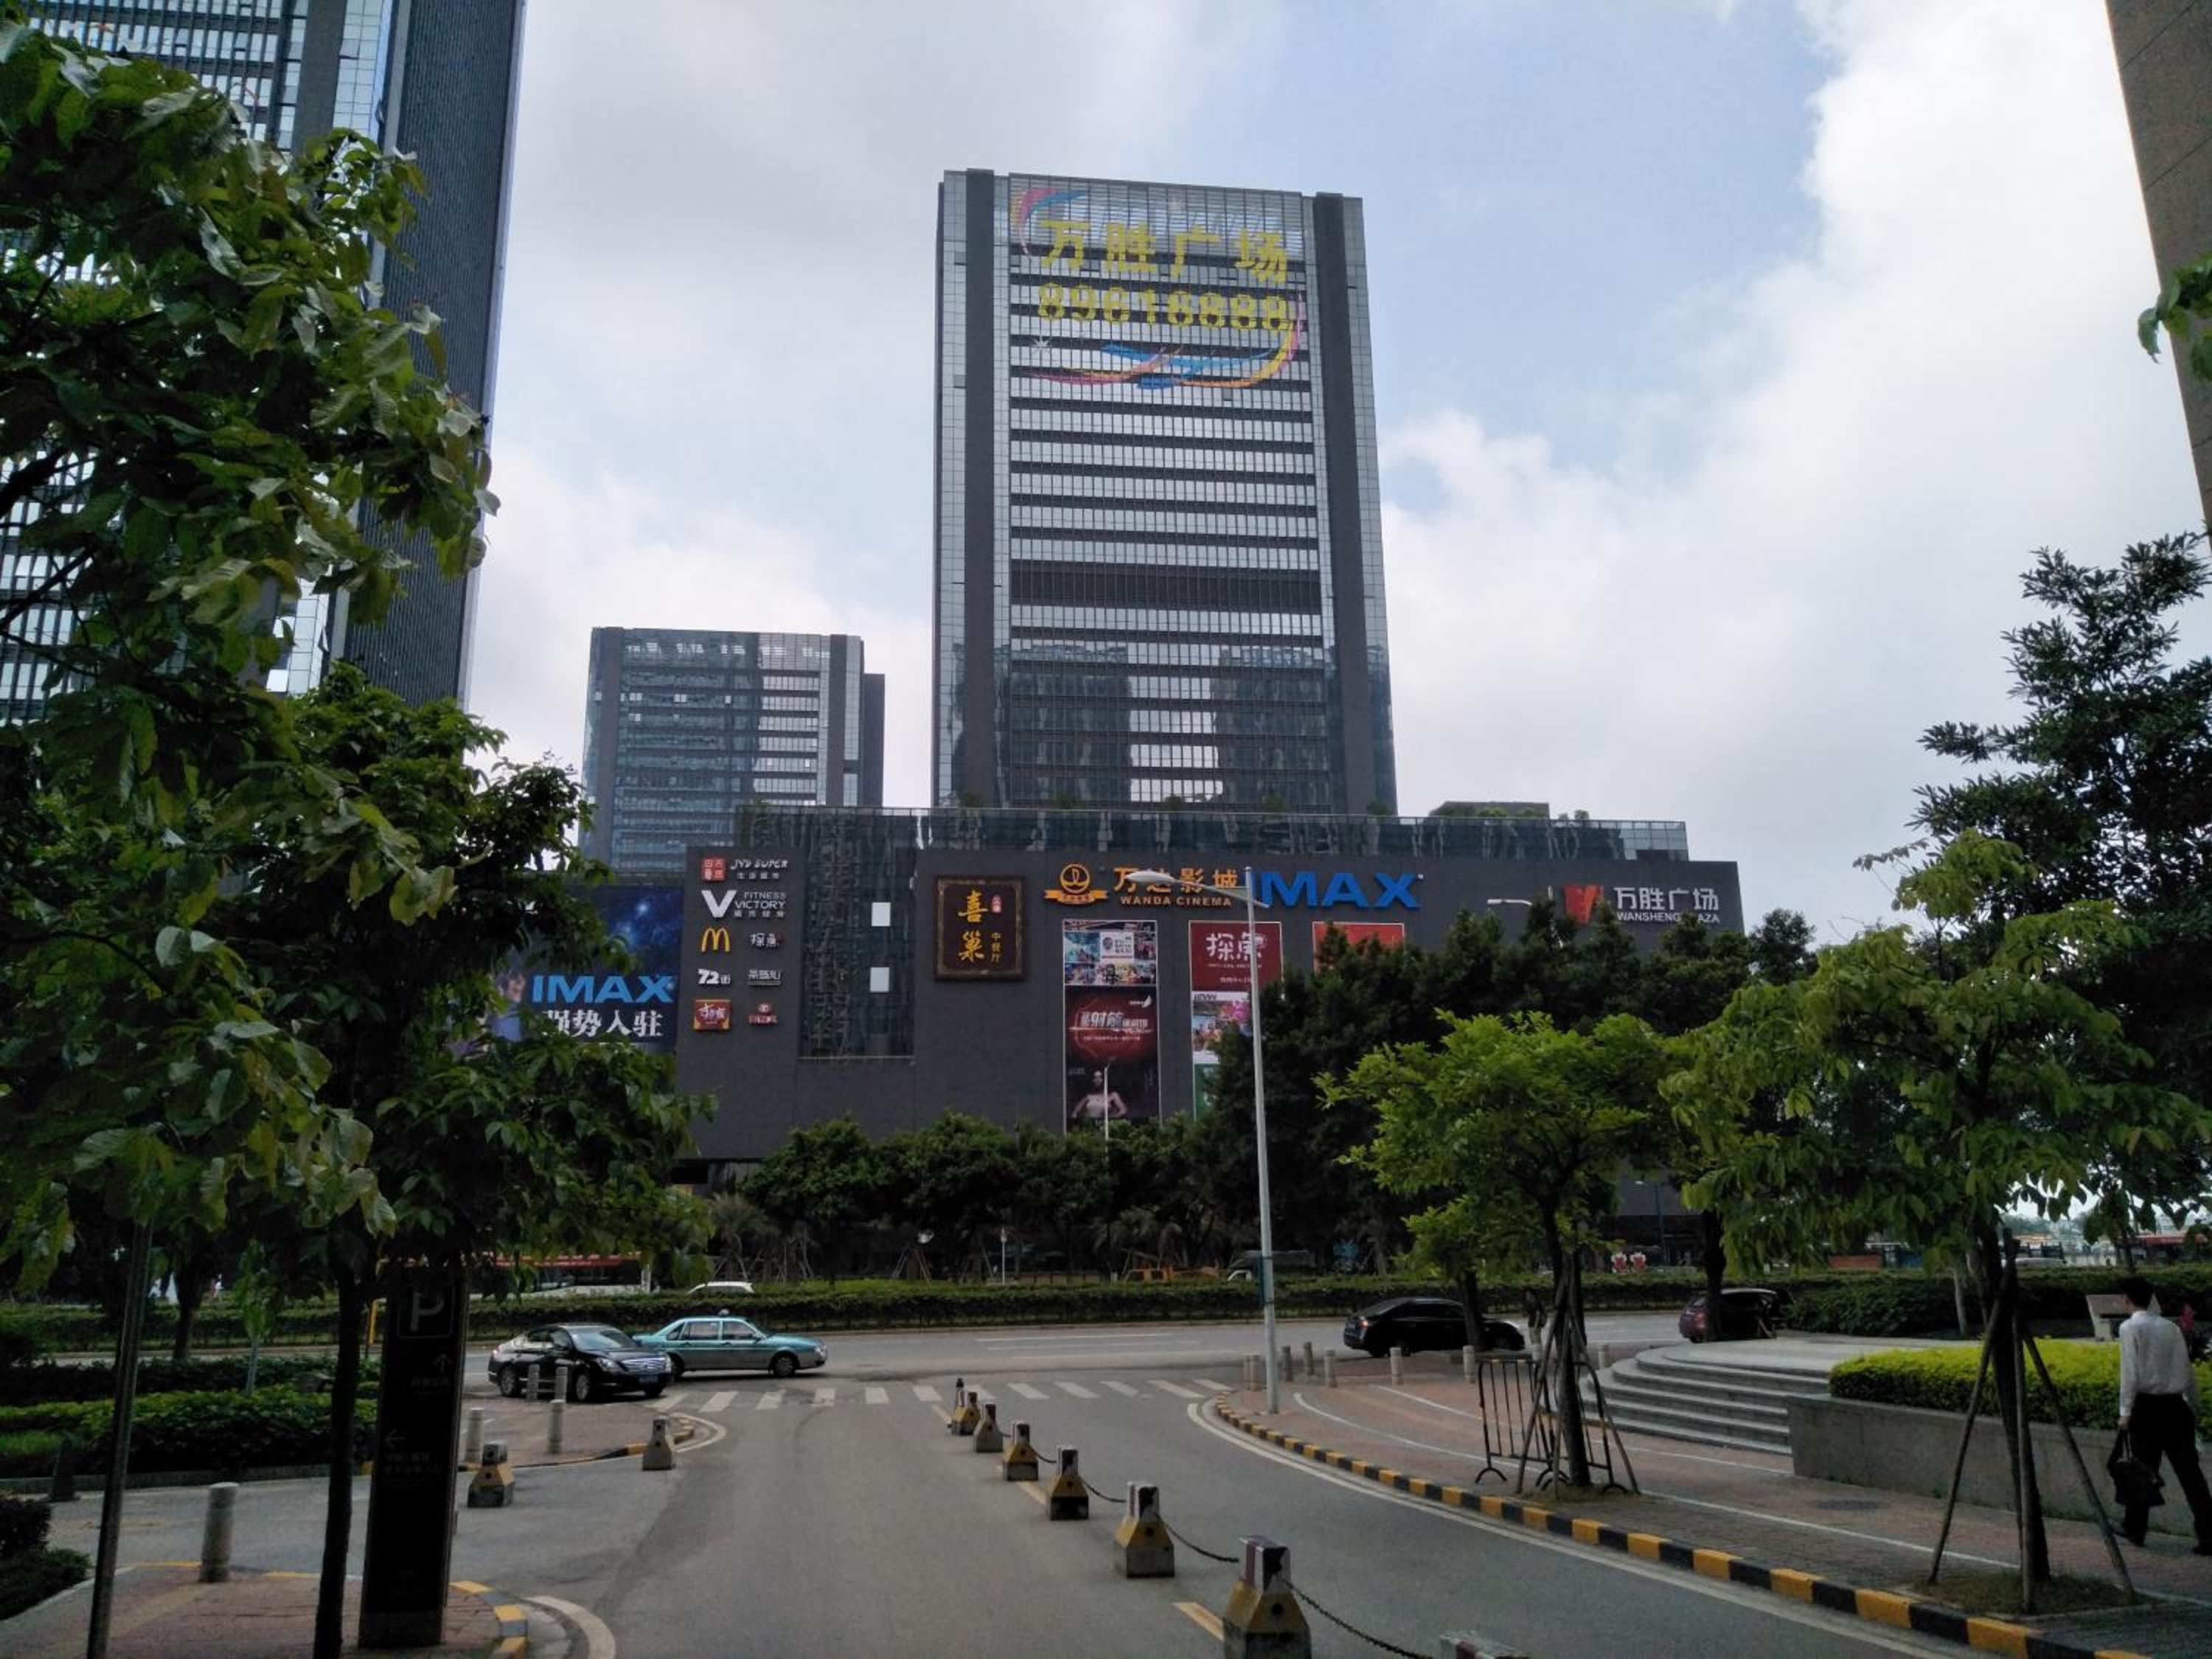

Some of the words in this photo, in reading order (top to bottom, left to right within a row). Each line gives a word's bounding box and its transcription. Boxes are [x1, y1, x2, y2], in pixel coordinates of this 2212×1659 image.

[1037, 220, 1287, 283] 万胜广场
[744, 891, 787, 900] FITNESS
[1120, 896, 1171, 905] WANDA
[1176, 896, 1232, 907] CINEMA
[1242, 872, 1417, 908] IMAX
[1613, 887, 1719, 911] 万胜广场
[734, 900, 786, 909] VICTORY
[698, 968, 731, 984] 72街
[532, 975, 673, 1003] IMAX
[409, 1290, 445, 1332] P
